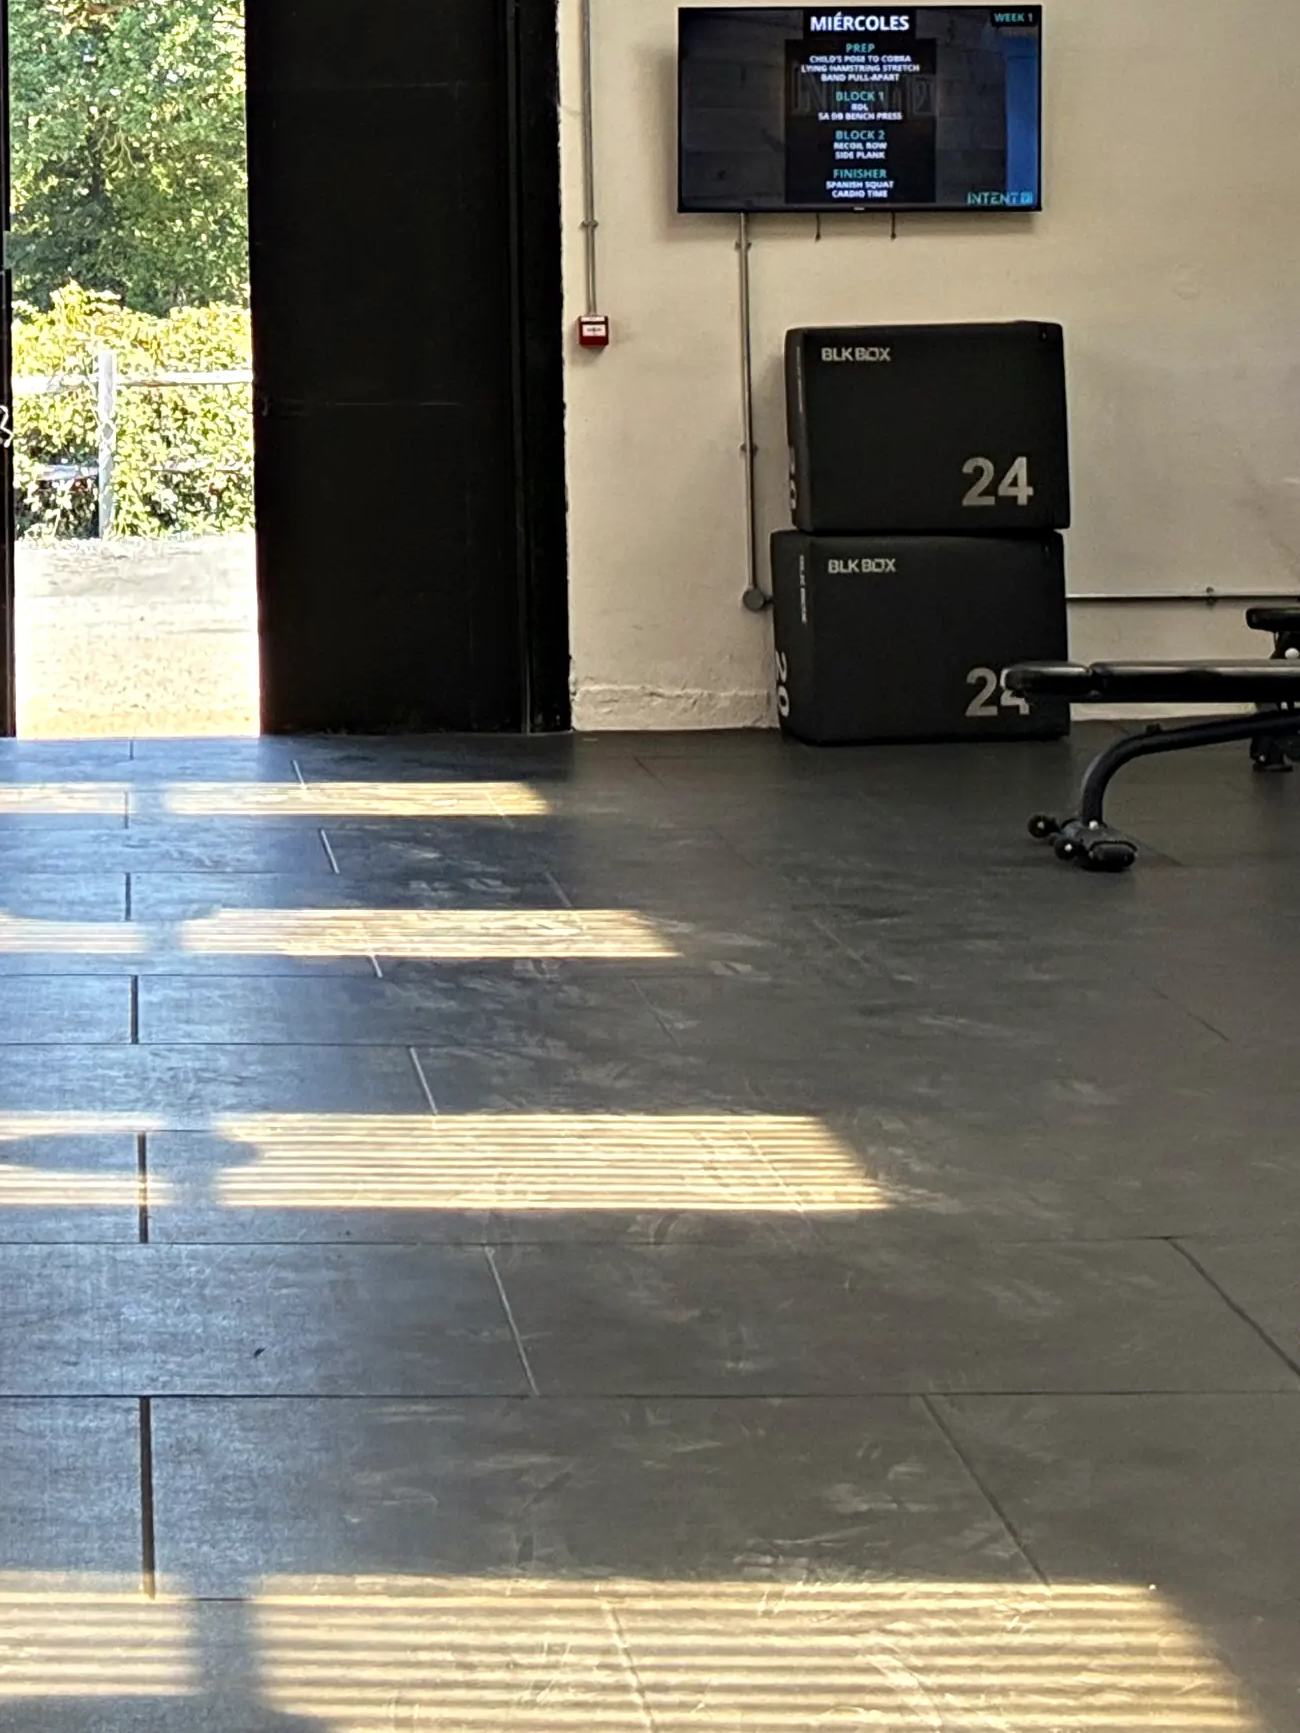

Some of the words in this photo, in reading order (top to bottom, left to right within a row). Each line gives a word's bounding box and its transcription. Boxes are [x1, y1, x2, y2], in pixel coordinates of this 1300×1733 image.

[810, 11, 910, 31] MIÉRCOLES
[994, 13, 1025, 23] WEEK
[1028, 13, 1034, 23] 1
[846, 43, 875, 53] PREP
[809, 55, 842, 63] CHILD'S
[868, 55, 879, 63] TO
[882, 64, 920, 72] STRETCH
[821, 74, 846, 82] BAND
[848, 73, 899, 82] PULL-APART
[835, 91, 875, 101] BLOCK
[878, 91, 884, 101] 1
[845, 112, 875, 121] BENCH
[876, 112, 902, 120] PRESS
[835, 130, 875, 140] BLOCK
[878, 130, 885, 140] 2
[835, 151, 854, 159] SIDE
[856, 151, 885, 159] PLANK
[833, 169, 887, 179] FINISHER
[865, 181, 894, 190] SQUAT
[967, 192, 1019, 204] INTENT
[821, 347, 854, 361] BLK
[854, 347, 891, 361] BOX
[962, 456, 1034, 506] 24
[828, 559, 860, 574] BLK
[861, 558, 897, 573] BOX
